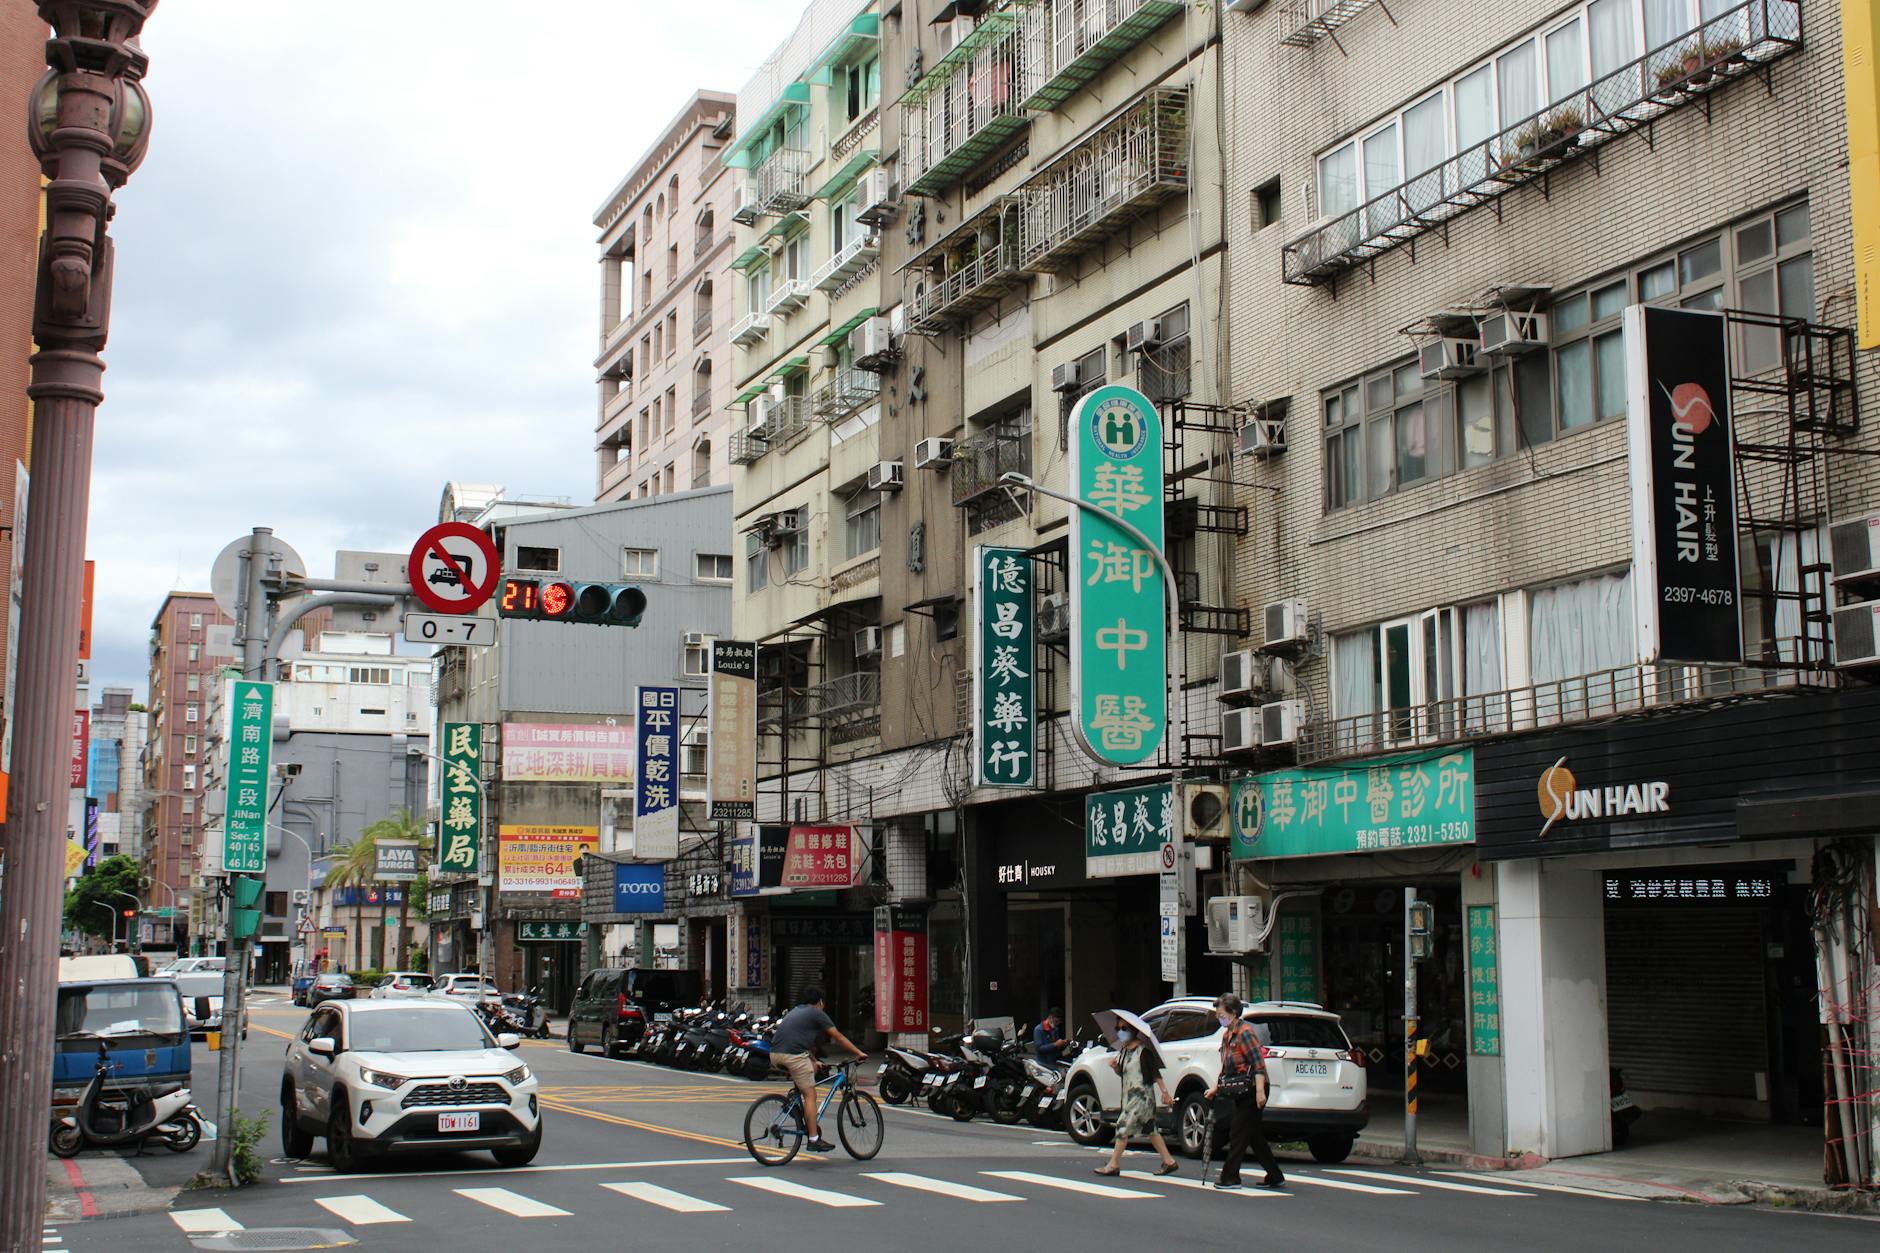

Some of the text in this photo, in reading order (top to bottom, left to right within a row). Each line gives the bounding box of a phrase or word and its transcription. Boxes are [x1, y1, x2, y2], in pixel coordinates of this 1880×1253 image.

[1658, 378, 1720, 562] SUN HAIR
[1664, 587, 1733, 606] 2397-4678
[1087, 461, 1156, 750] 華御中醫
[717, 661, 750, 670] Louie's
[986, 555, 1029, 779] 億昌蔘藥行
[238, 702, 264, 806] 濟南路二段
[644, 709, 672, 808] 平價乾洗
[444, 724, 479, 868] 民生藥局
[1269, 754, 1469, 832] 華御中醫診所
[1538, 756, 1670, 839] SUN HAIR
[231, 810, 260, 819] JiNan
[713, 807, 752, 818] 23211285
[231, 821, 249, 830] Rd.
[231, 831, 260, 841] Sec. 2
[378, 849, 416, 861] LAYA
[378, 861, 415, 870] BURGER
[1030, 865, 1056, 878] HOUSKY
[619, 883, 661, 894] TOTO
